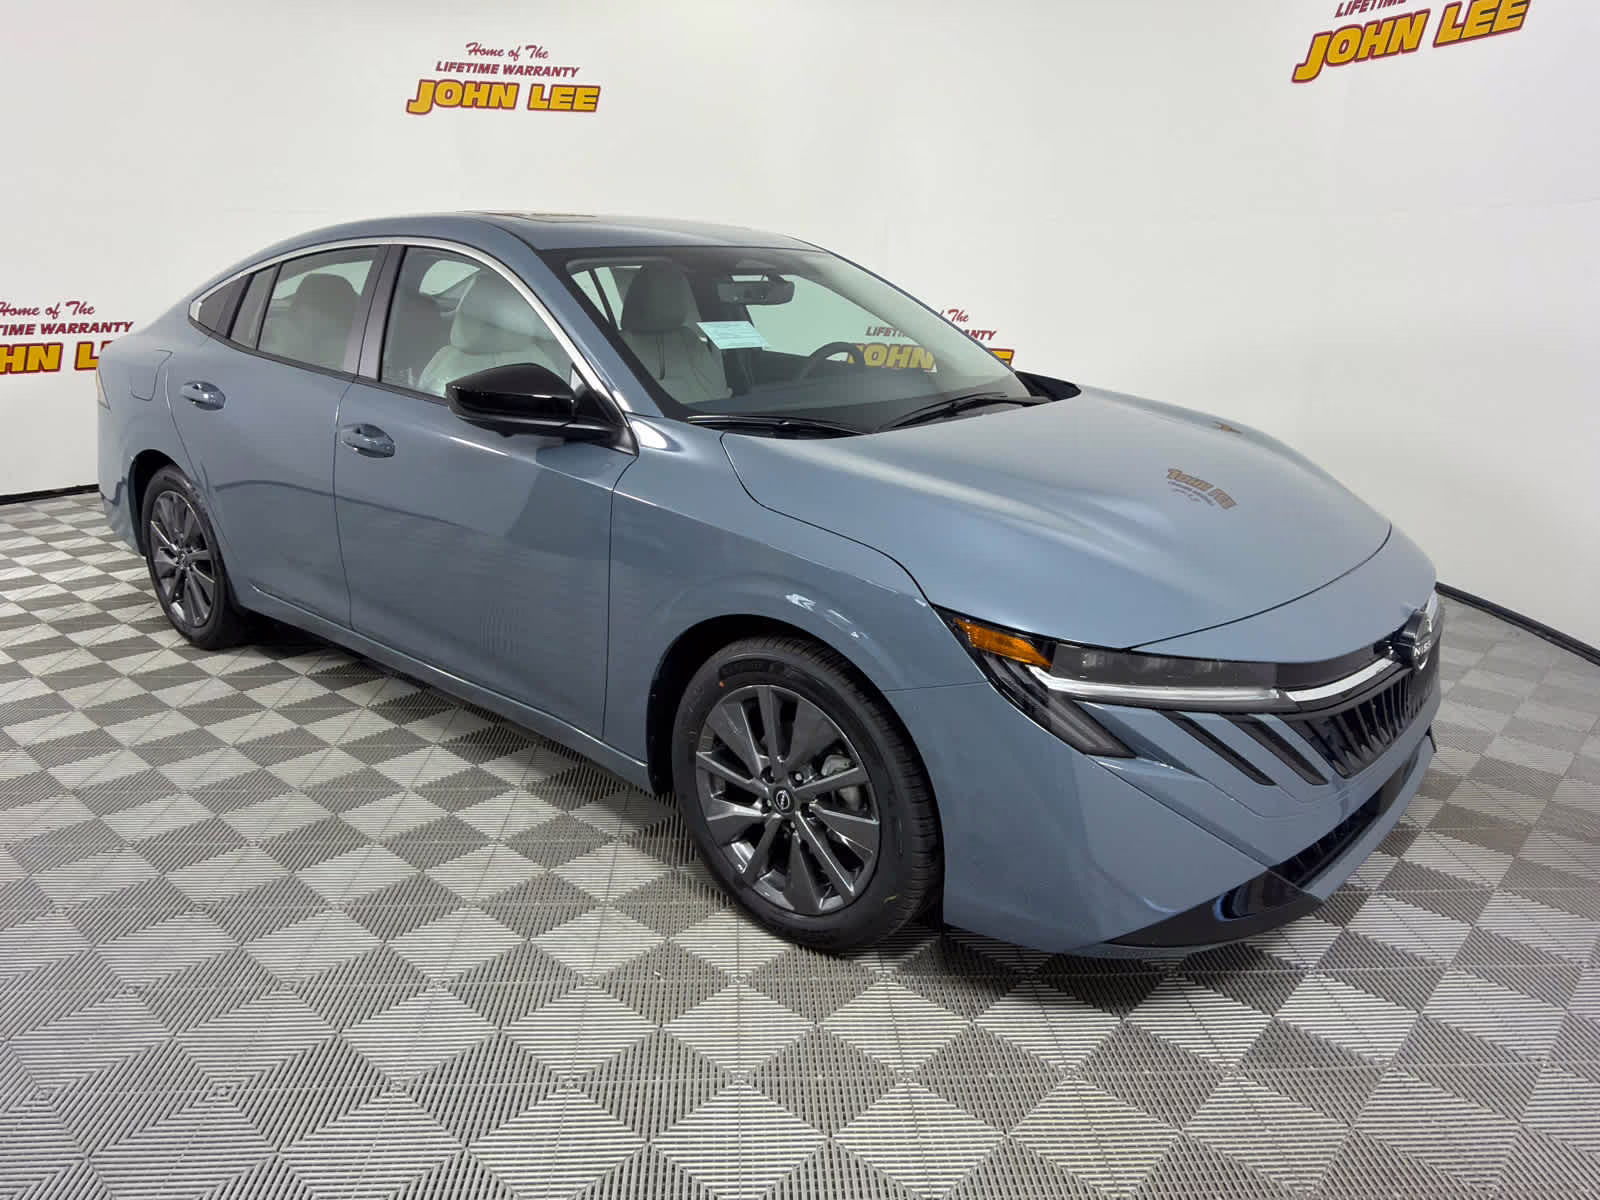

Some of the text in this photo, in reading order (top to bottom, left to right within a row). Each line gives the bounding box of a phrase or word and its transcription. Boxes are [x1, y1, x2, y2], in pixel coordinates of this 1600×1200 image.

[1334, 0, 1407, 18] LIFETI
[1291, 0, 1532, 83] JOHN LEE
[465, 41, 549, 62] Home of The
[435, 61, 580, 78] LIFETIME WARRANTY
[406, 79, 601, 115] JOHN LEE
[0, 300, 96, 319] Home of The
[947, 308, 970, 323] The
[40, 321, 134, 335] WARRANTY
